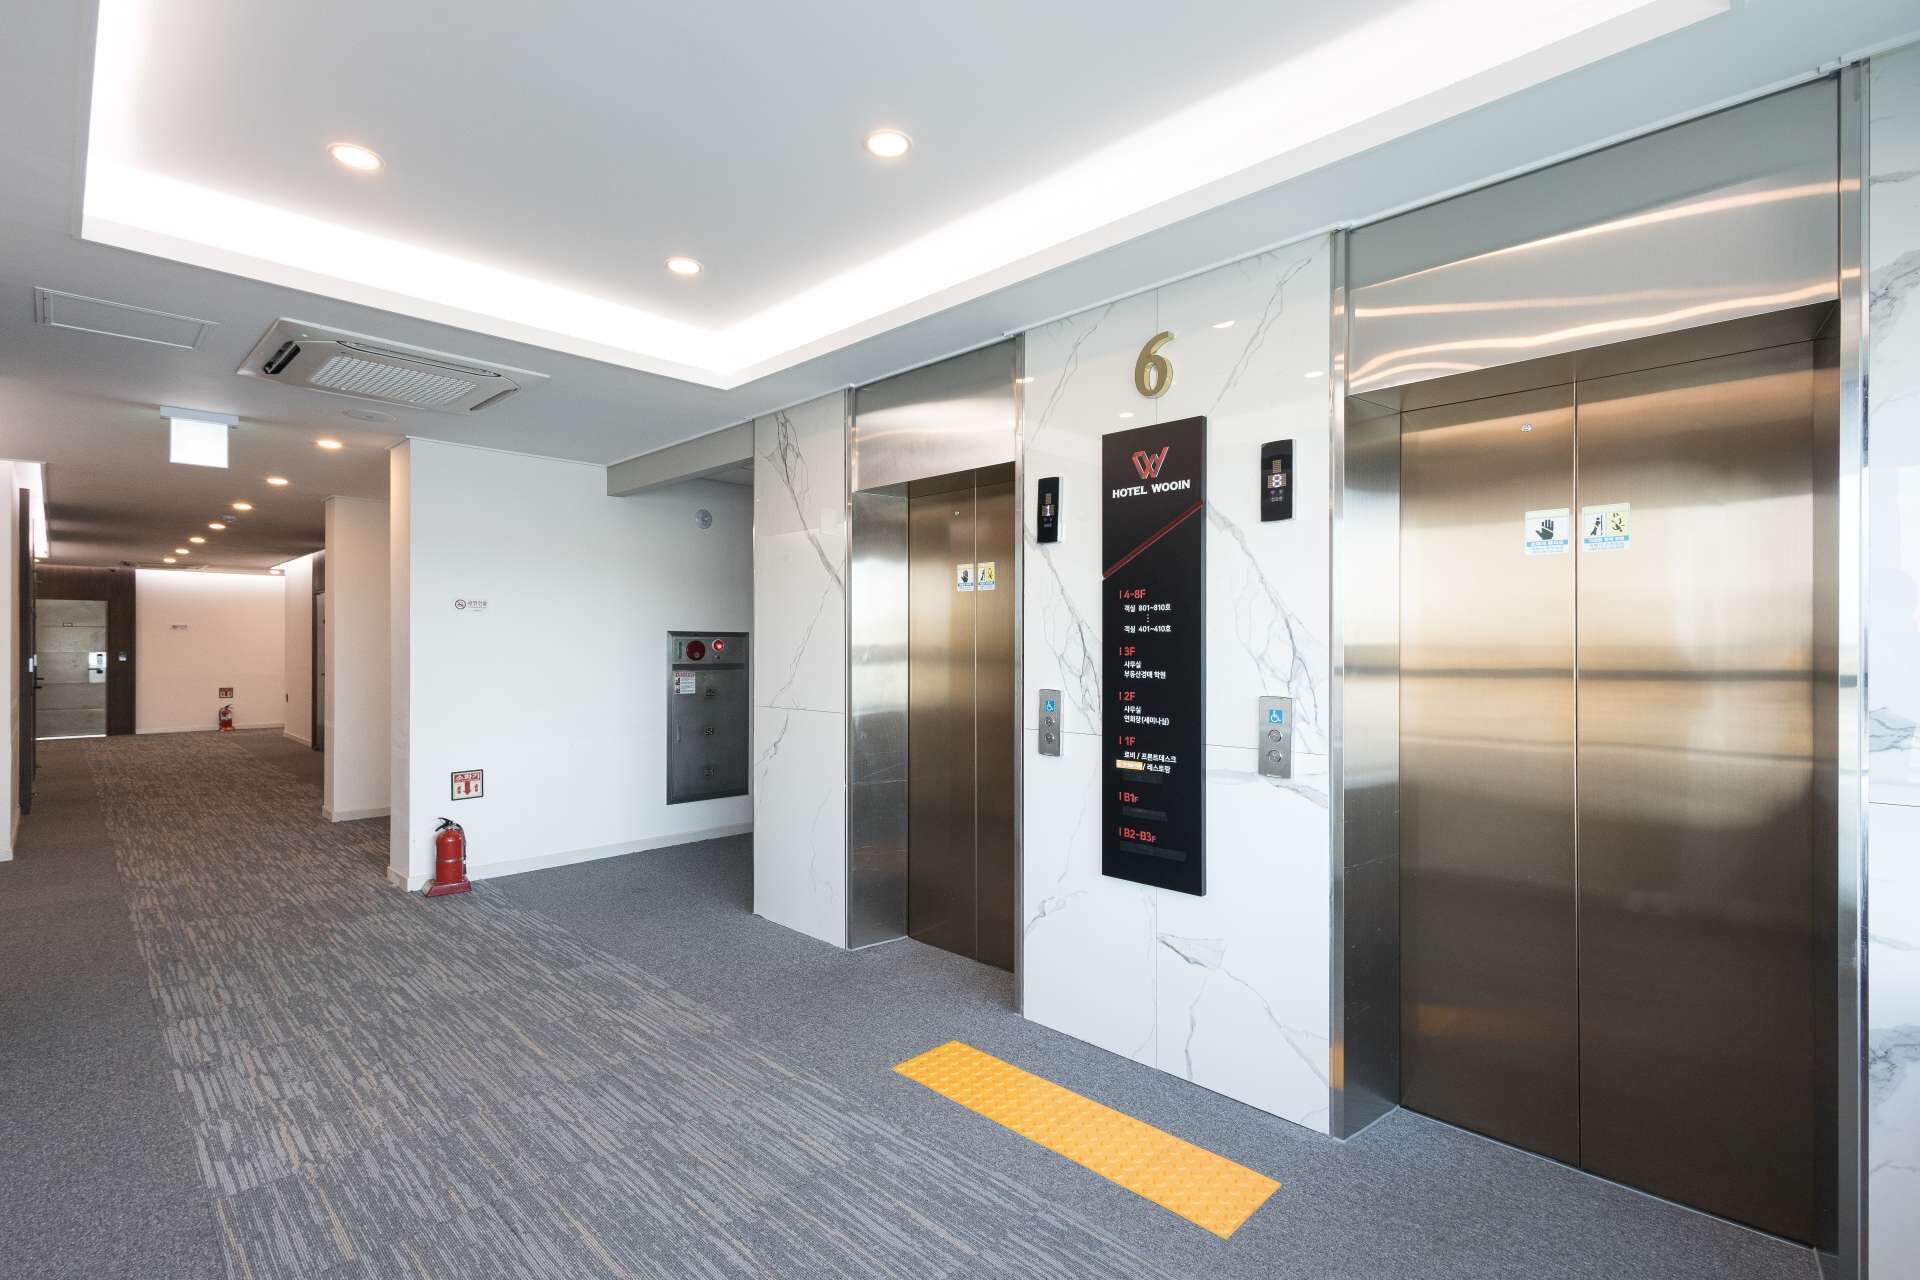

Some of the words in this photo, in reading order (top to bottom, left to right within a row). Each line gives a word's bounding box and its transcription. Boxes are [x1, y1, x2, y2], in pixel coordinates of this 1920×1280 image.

[1134, 330, 1175, 399] 6
[1112, 485, 1148, 499] HOTEL
[1151, 479, 1191, 494] WOOIN
[1124, 604, 1136, 613] 객실
[1124, 625, 1136, 634] 객실
[1124, 646, 1136, 657] 3F
[1124, 660, 1142, 669] 사무실
[1123, 670, 1153, 679] 부동산경매
[1154, 671, 1167, 680] 학원
[1124, 691, 1136, 701] 2F
[1124, 705, 1142, 714] 사무실
[1124, 735, 1136, 747] 1F
[1123, 751, 1136, 760] 로비
[1141, 753, 1177, 763] 프론트데스크
[1146, 763, 1171, 774] 레스토랑
